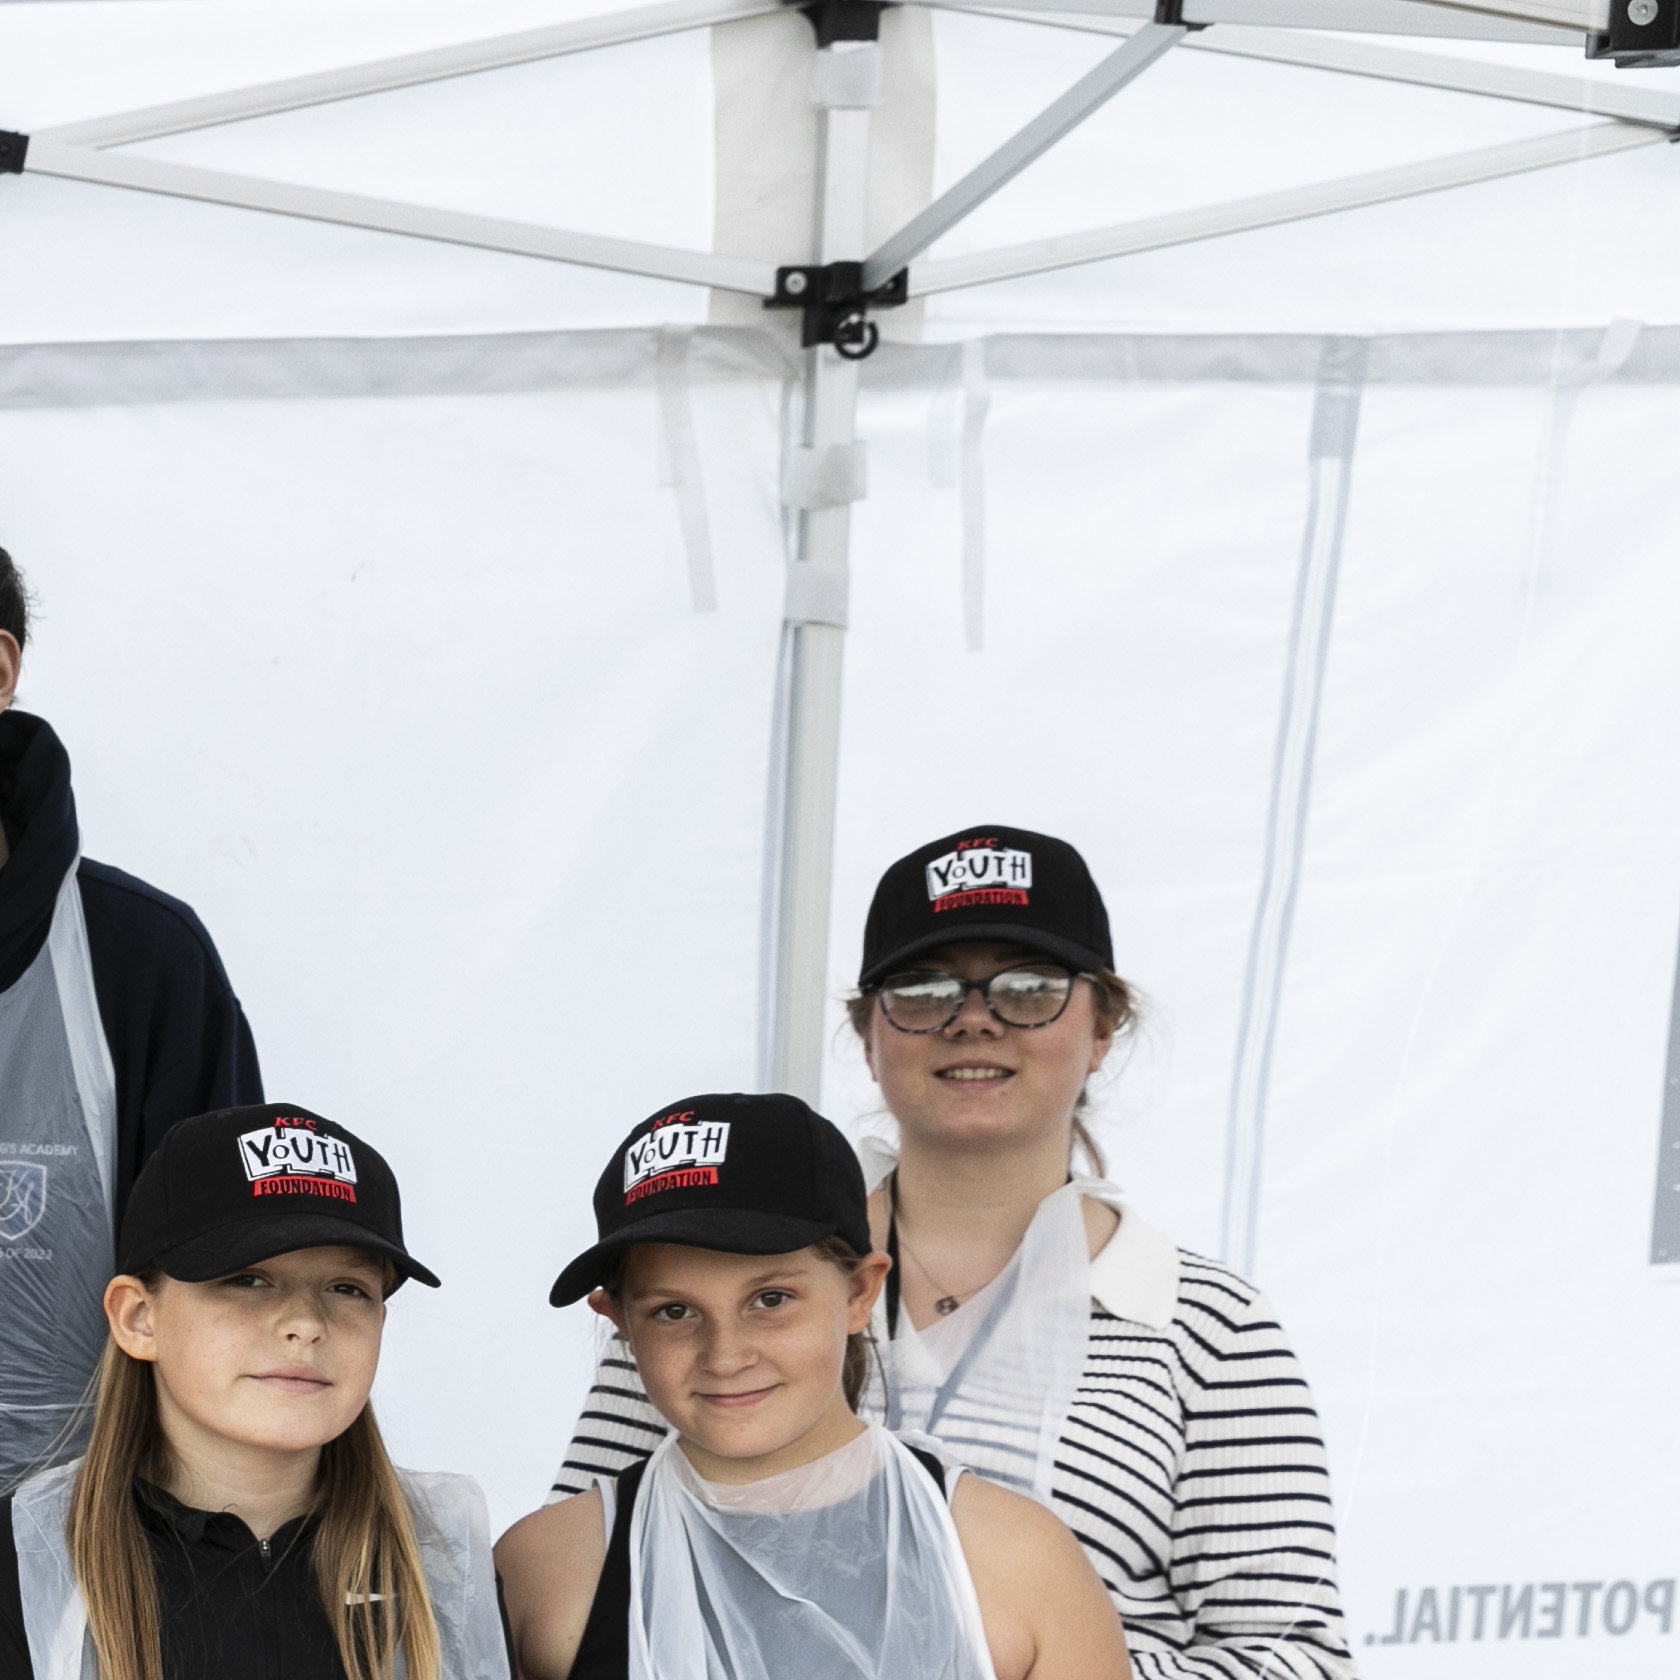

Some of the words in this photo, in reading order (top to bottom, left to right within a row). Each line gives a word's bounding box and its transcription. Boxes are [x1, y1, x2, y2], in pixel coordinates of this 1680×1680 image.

[957, 837, 999, 851] KFC
[933, 855, 1026, 887] YOUTH
[274, 1116, 318, 1131] KFC
[651, 1111, 695, 1132] KFC
[20, 1143, 79, 1156] ACADEMY
[246, 1134, 351, 1173] YOUTH
[630, 1127, 723, 1175] YOUTH
[260, 1179, 352, 1201] FOUNDATION
[626, 1171, 711, 1205] FOUNDATION
